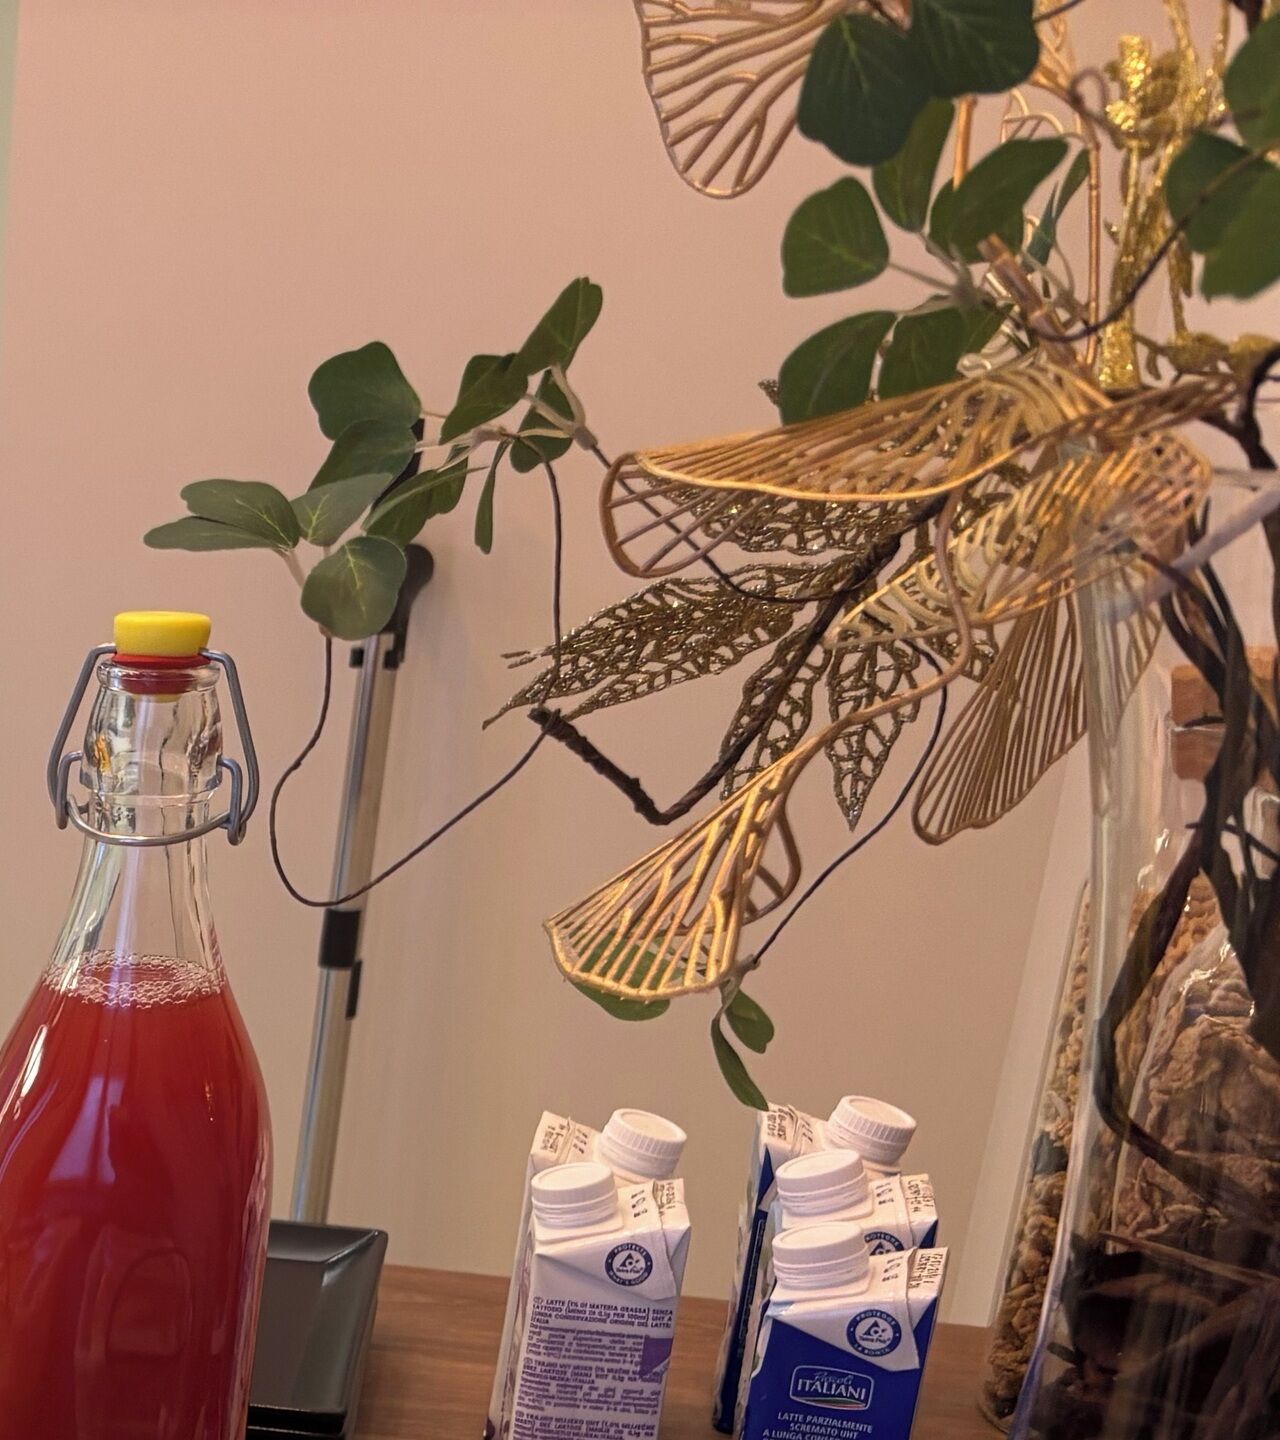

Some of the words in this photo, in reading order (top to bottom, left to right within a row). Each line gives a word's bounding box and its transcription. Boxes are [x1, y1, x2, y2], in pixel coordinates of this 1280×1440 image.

[797, 1379, 866, 1401] ITALIANI
[778, 1412, 804, 1422] LATTE
[806, 1415, 873, 1433] PARZIALMENTE
[790, 1423, 838, 1436] SCREMATO
[840, 1430, 859, 1440] UHT
[762, 1429, 770, 1437] A
[772, 1430, 803, 1440] LUNGA
